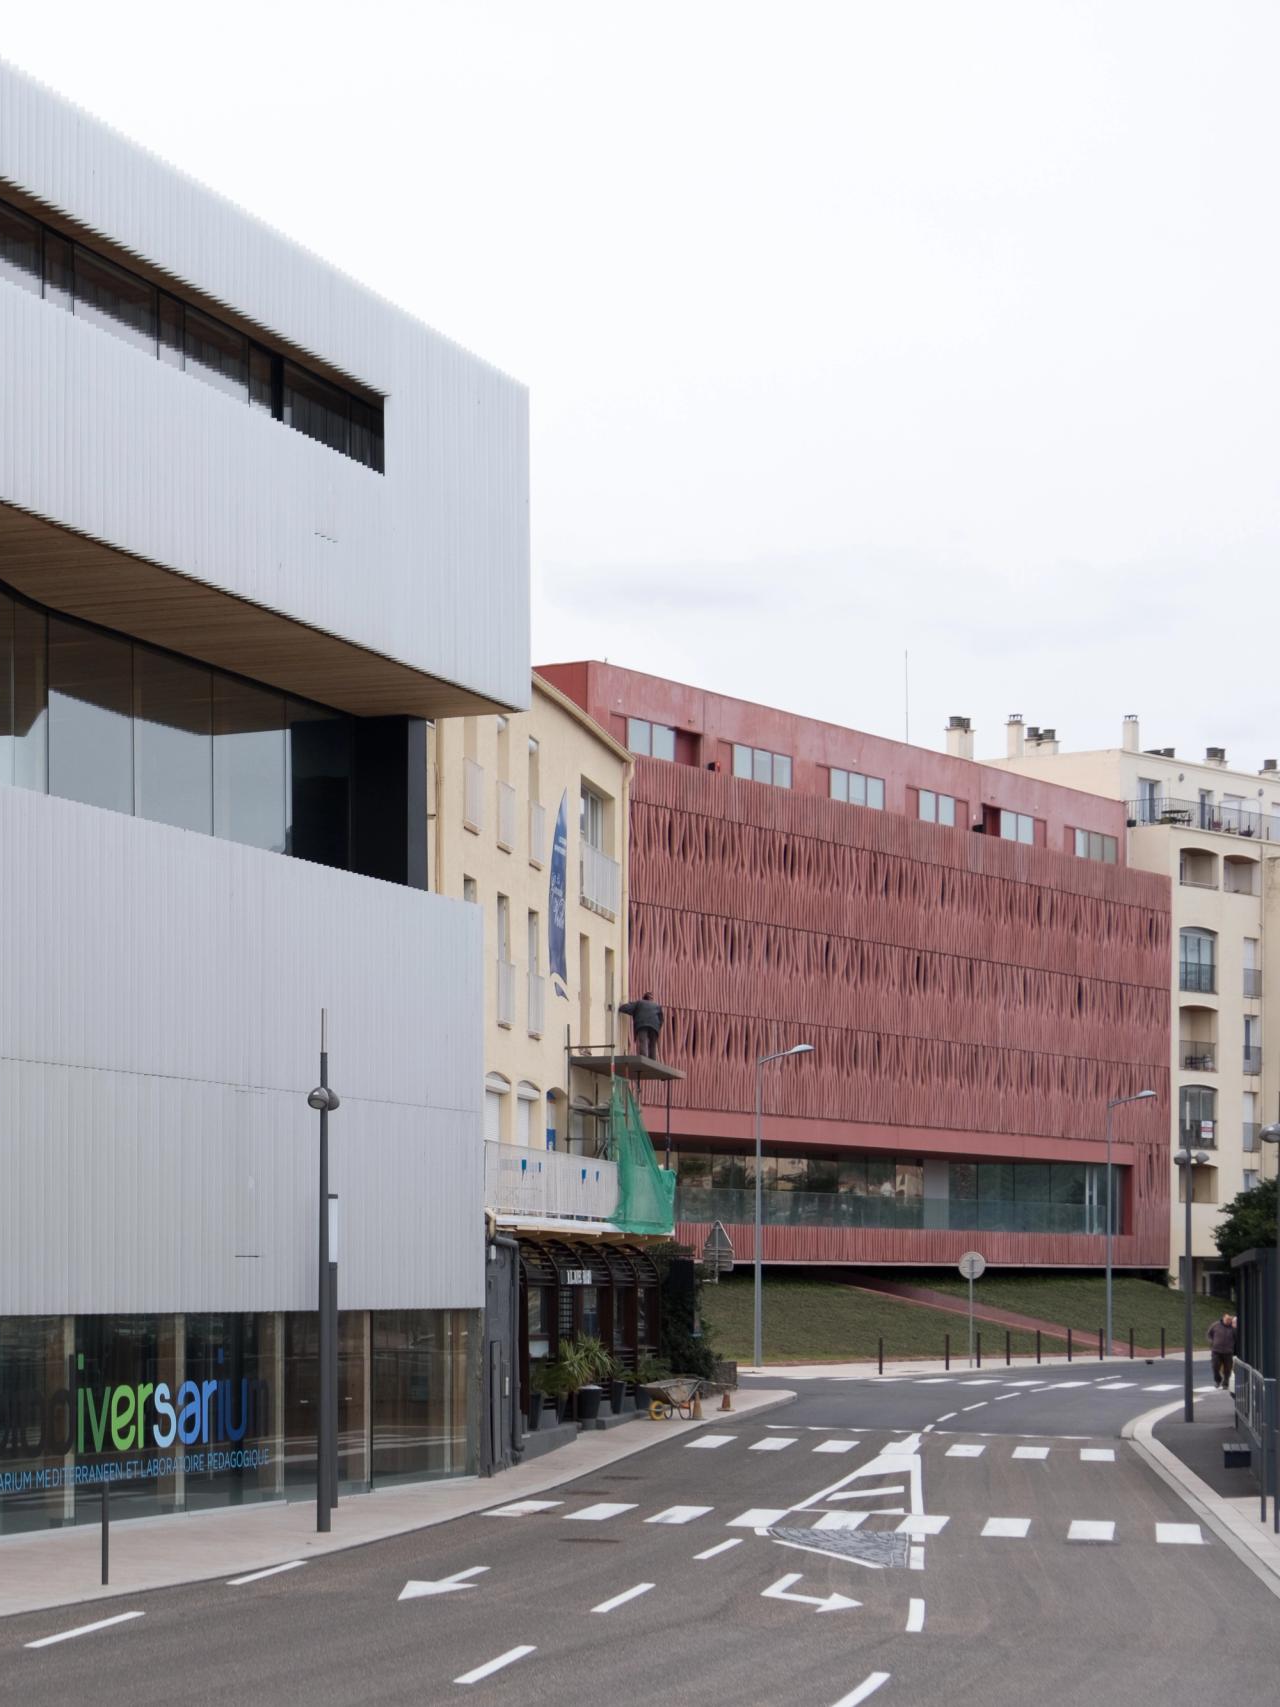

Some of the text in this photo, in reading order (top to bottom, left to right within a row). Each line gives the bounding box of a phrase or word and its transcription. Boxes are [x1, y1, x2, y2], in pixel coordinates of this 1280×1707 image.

[35, 1461, 124, 1489] MEDITERRANEEN
[126, 1460, 138, 1480] ET
[140, 1454, 205, 1478] LABORATOIRE
[207, 1448, 270, 1472] PEDAGOGIQUE
